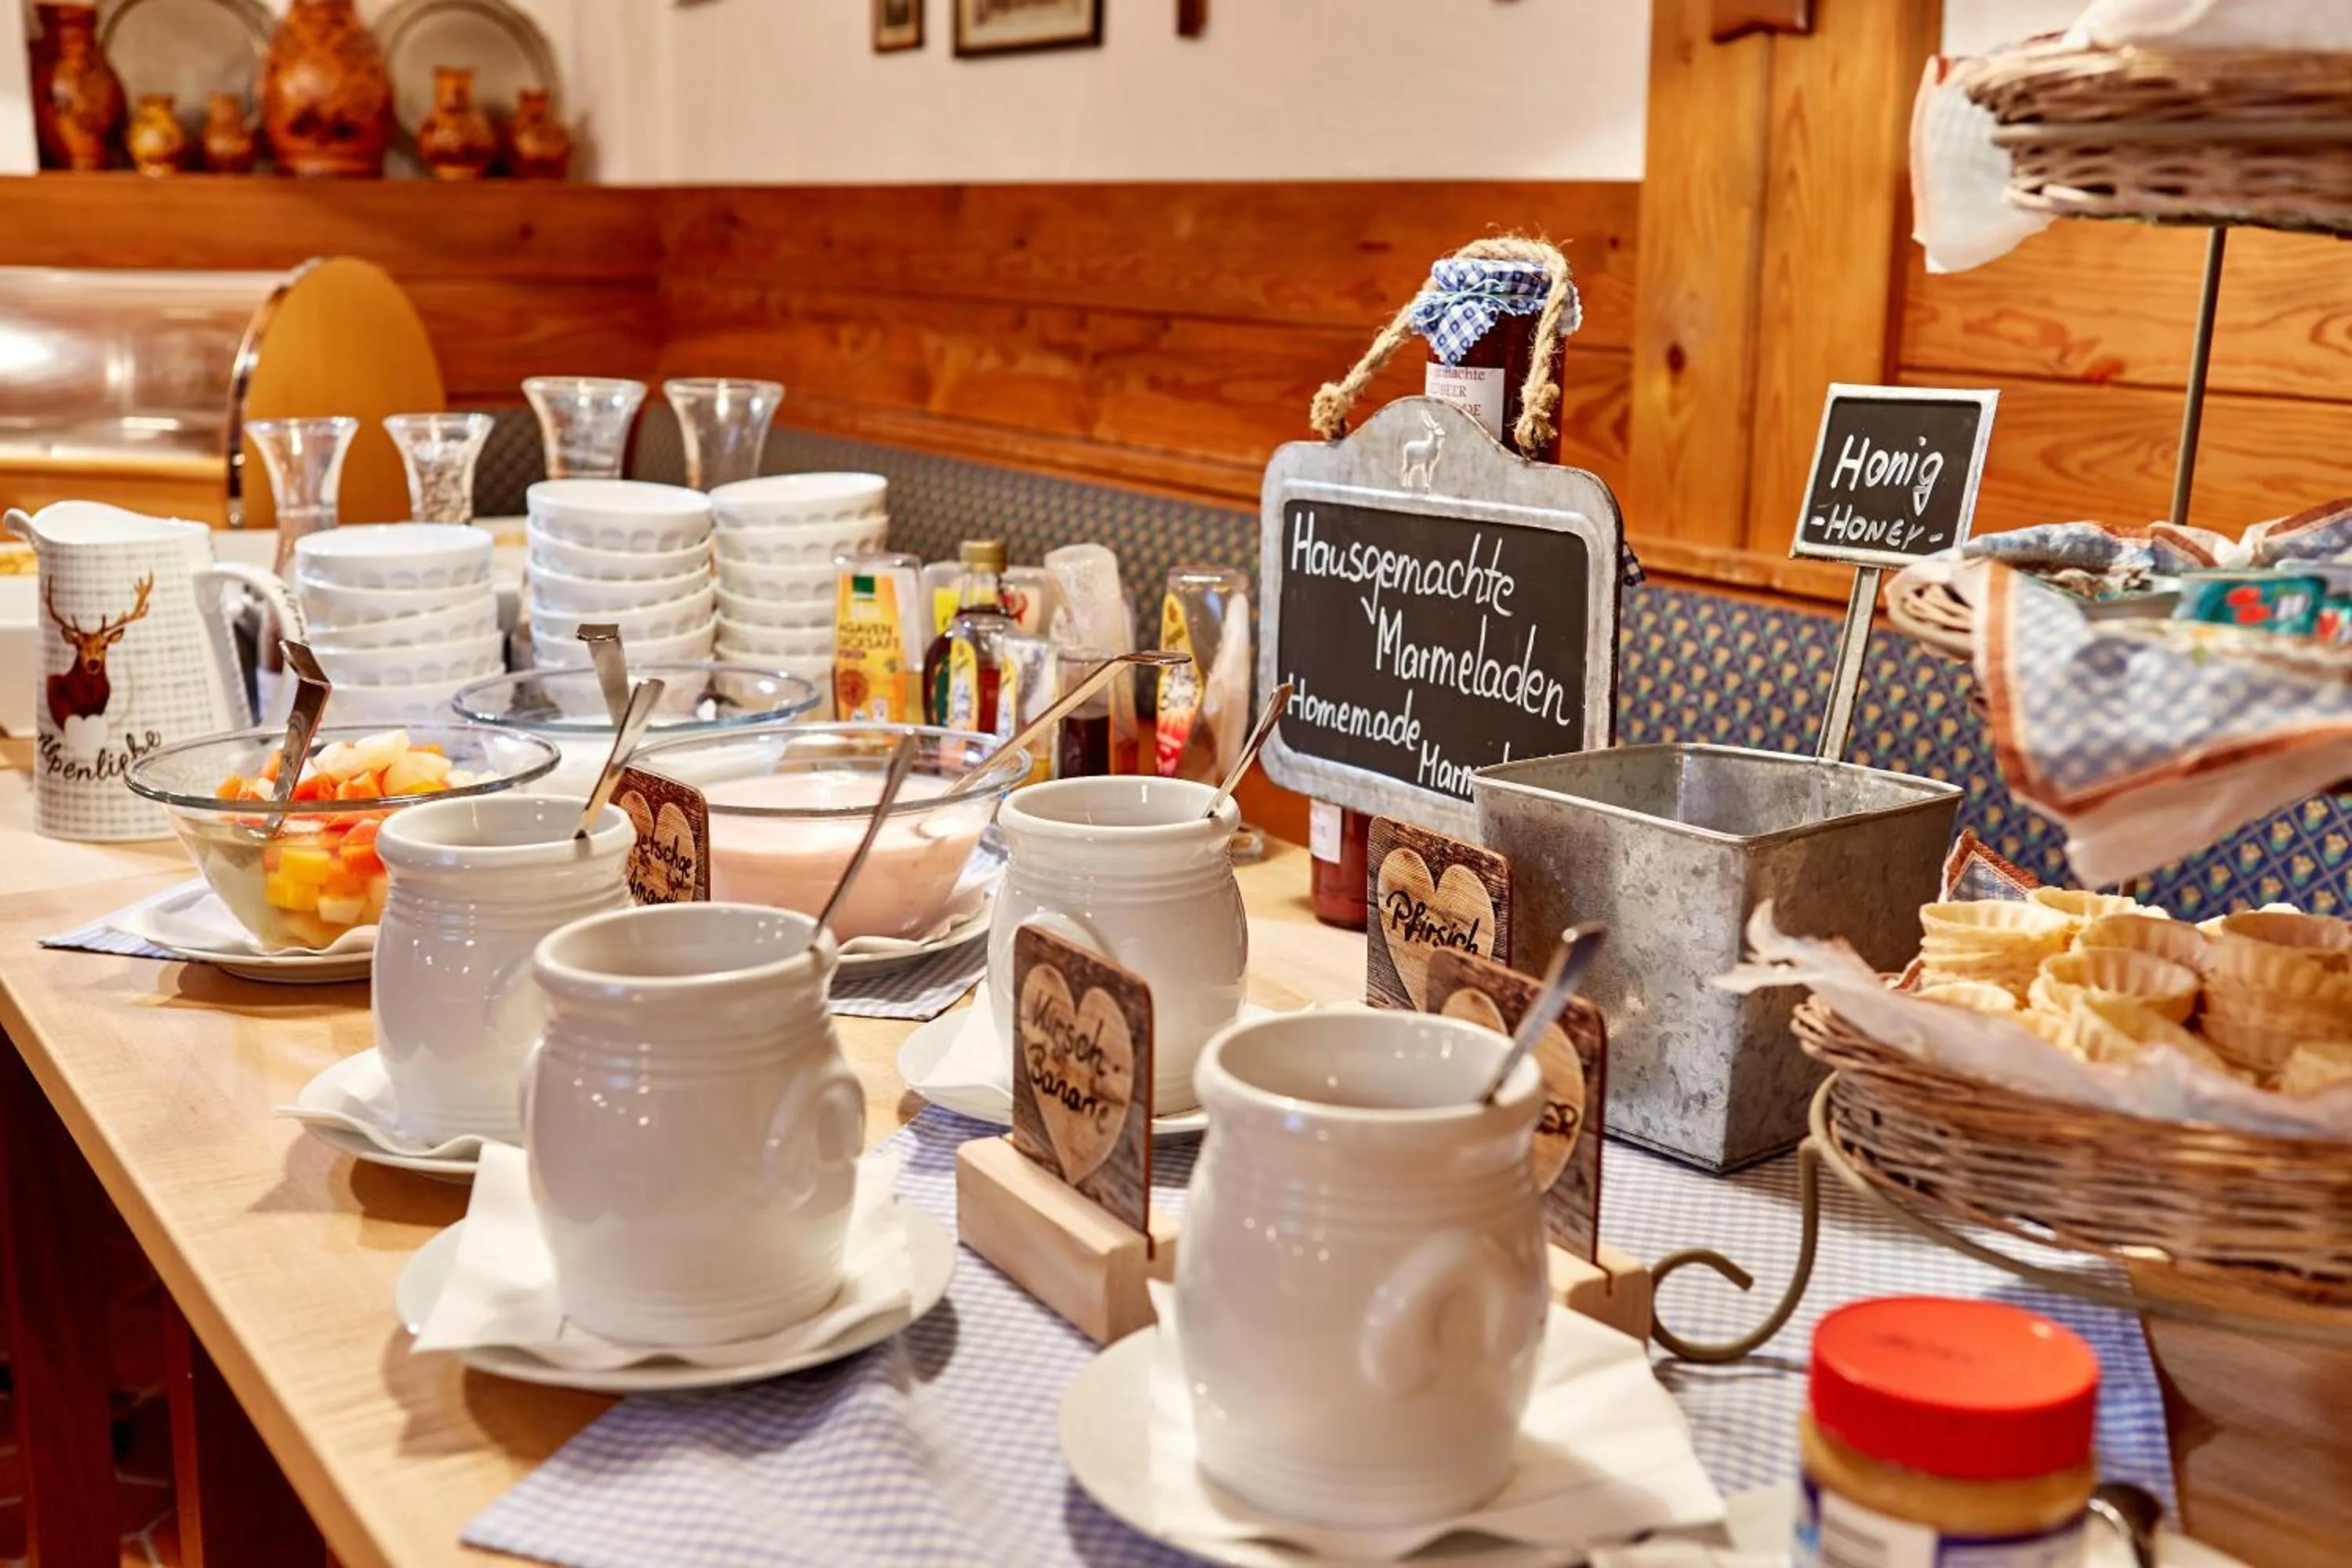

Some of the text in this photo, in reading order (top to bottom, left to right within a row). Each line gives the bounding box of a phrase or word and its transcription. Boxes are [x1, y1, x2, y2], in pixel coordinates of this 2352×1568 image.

[1830, 434, 1944, 517] Honig
[1291, 511, 1515, 626] Hausgemachte
[1375, 606, 1570, 726] Marmeladen
[1287, 673, 1421, 750] Homemade
[1386, 890, 1480, 954] Pfirsich
